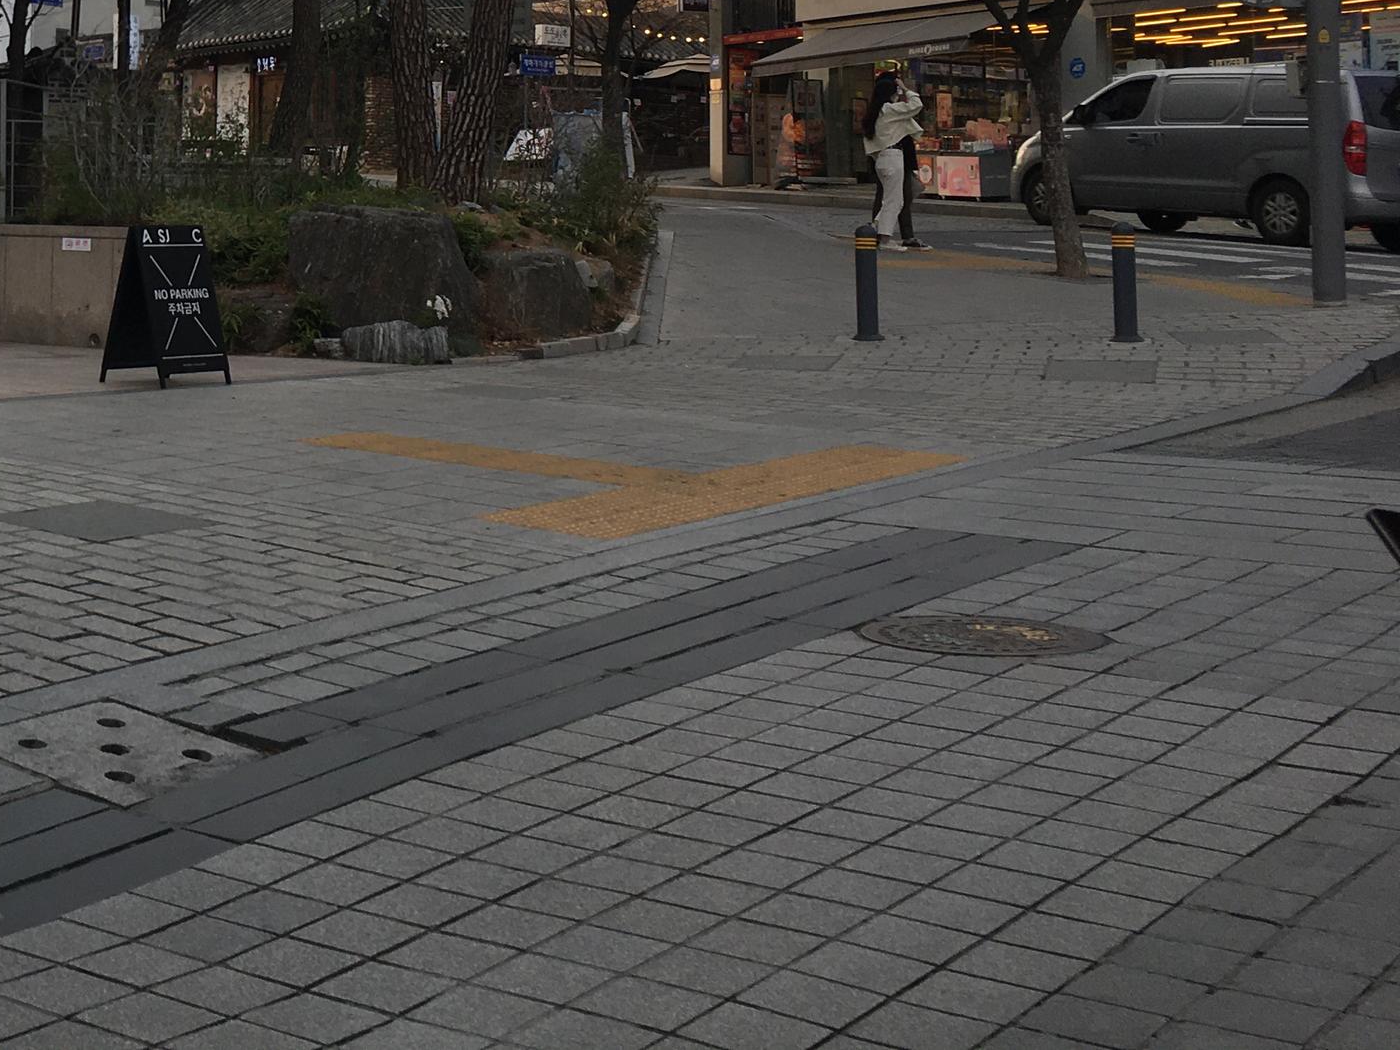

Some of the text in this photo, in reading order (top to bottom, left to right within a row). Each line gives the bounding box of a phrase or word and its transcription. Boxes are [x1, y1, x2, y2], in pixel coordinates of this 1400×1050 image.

[142, 228, 203, 244] A SJ C
[154, 287, 210, 301] NO PARKING
[167, 302, 201, 316] 주차금지
